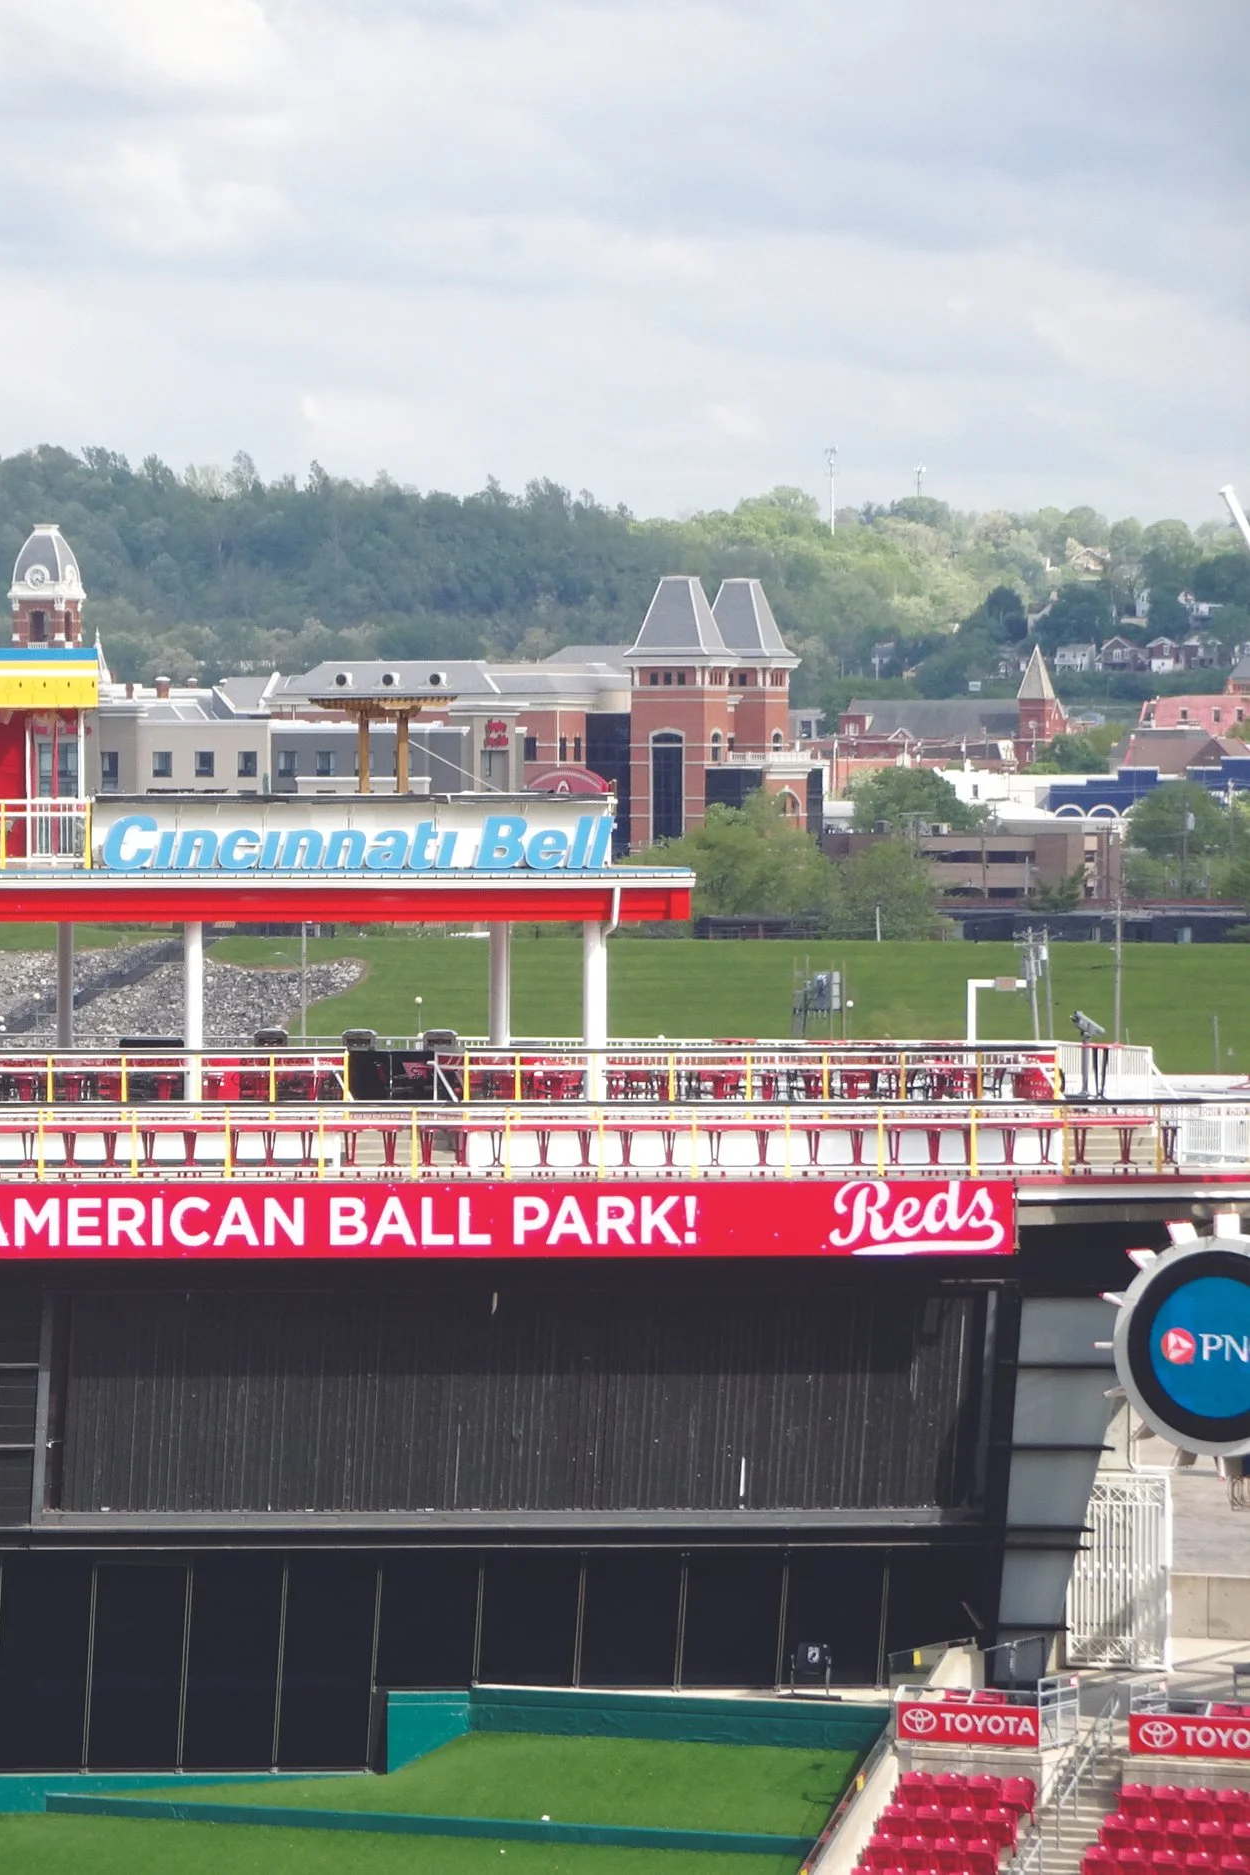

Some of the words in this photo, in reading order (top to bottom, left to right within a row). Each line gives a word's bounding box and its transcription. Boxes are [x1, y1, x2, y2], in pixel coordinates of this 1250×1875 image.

[102, 815, 458, 869] Cincinnati
[477, 815, 614, 869] Bell
[329, 1196, 492, 1248] BALL
[513, 1195, 699, 1246] PARK!
[828, 1181, 1005, 1256] Reds
[1198, 1332, 1250, 1363] PN
[940, 1711, 1036, 1738] TOYOTA
